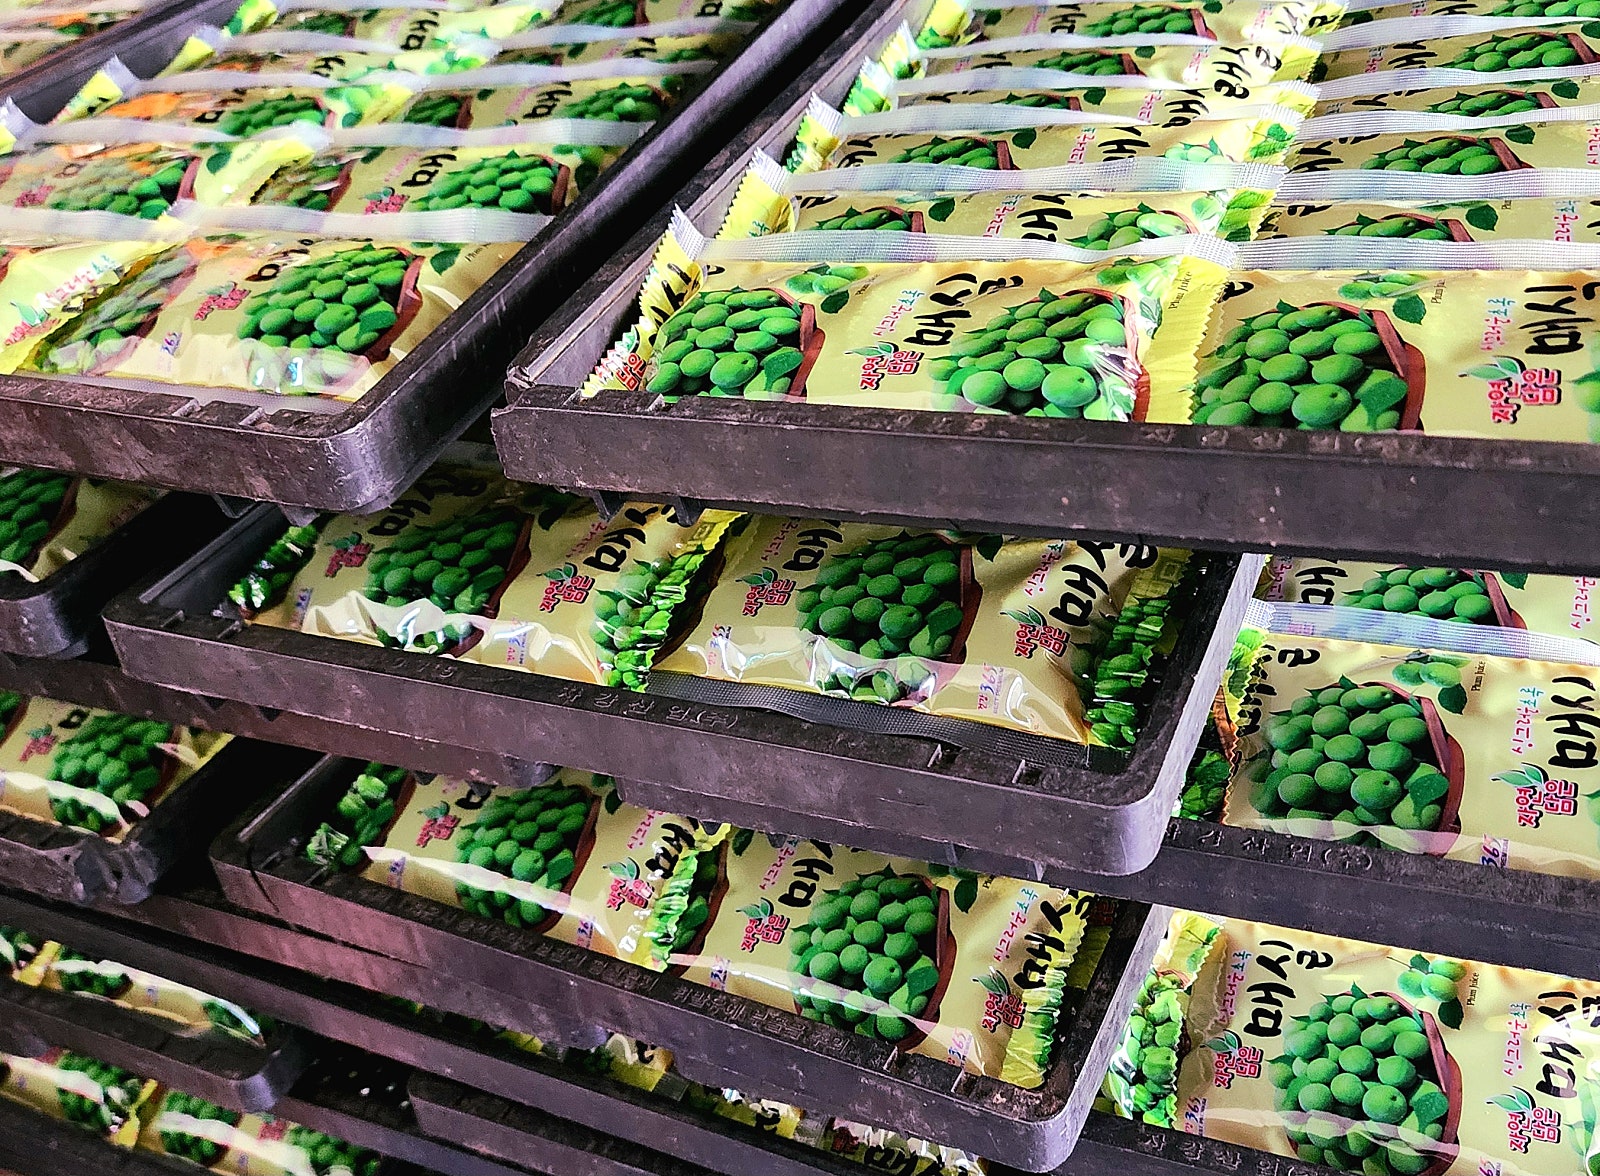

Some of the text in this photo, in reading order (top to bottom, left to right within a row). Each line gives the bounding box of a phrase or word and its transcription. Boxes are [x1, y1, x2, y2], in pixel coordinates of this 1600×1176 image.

[903, 272, 1024, 346] 매실
[860, 356, 889, 390] 자연
[886, 350, 924, 375] 담은
[1487, 378, 1521, 423] 자연
[1520, 367, 1562, 407] 담은
[782, 519, 843, 571] 매
[539, 579, 568, 612] 자연
[742, 585, 768, 616] 자연
[764, 578, 796, 606] 담은
[1570, 576, 1596, 629] 싱그러운
[1014, 623, 1041, 657] 자연
[979, 662, 998, 695] 365
[1511, 686, 1545, 754] 싱그러운 초록
[1515, 787, 1543, 828] 자연
[1543, 778, 1578, 816] 담은
[740, 917, 765, 953] 자연
[762, 914, 790, 945] 담은
[993, 911, 1027, 962] 싱그러운
[1218, 949, 1252, 1023] 싱그러운 초록
[1243, 940, 1334, 1037] 매실
[1466, 972, 1480, 1006] Plum Juice
[1502, 1001, 1533, 1076] 싱그러운 초록
[1213, 1052, 1237, 1089] 자연
[1235, 1044, 1263, 1078] 담은
[1184, 1096, 1200, 1123] 365
[1531, 1106, 1562, 1144] 담은
[1506, 1111, 1531, 1154] 자연
[1478, 1156, 1495, 1176] 65
